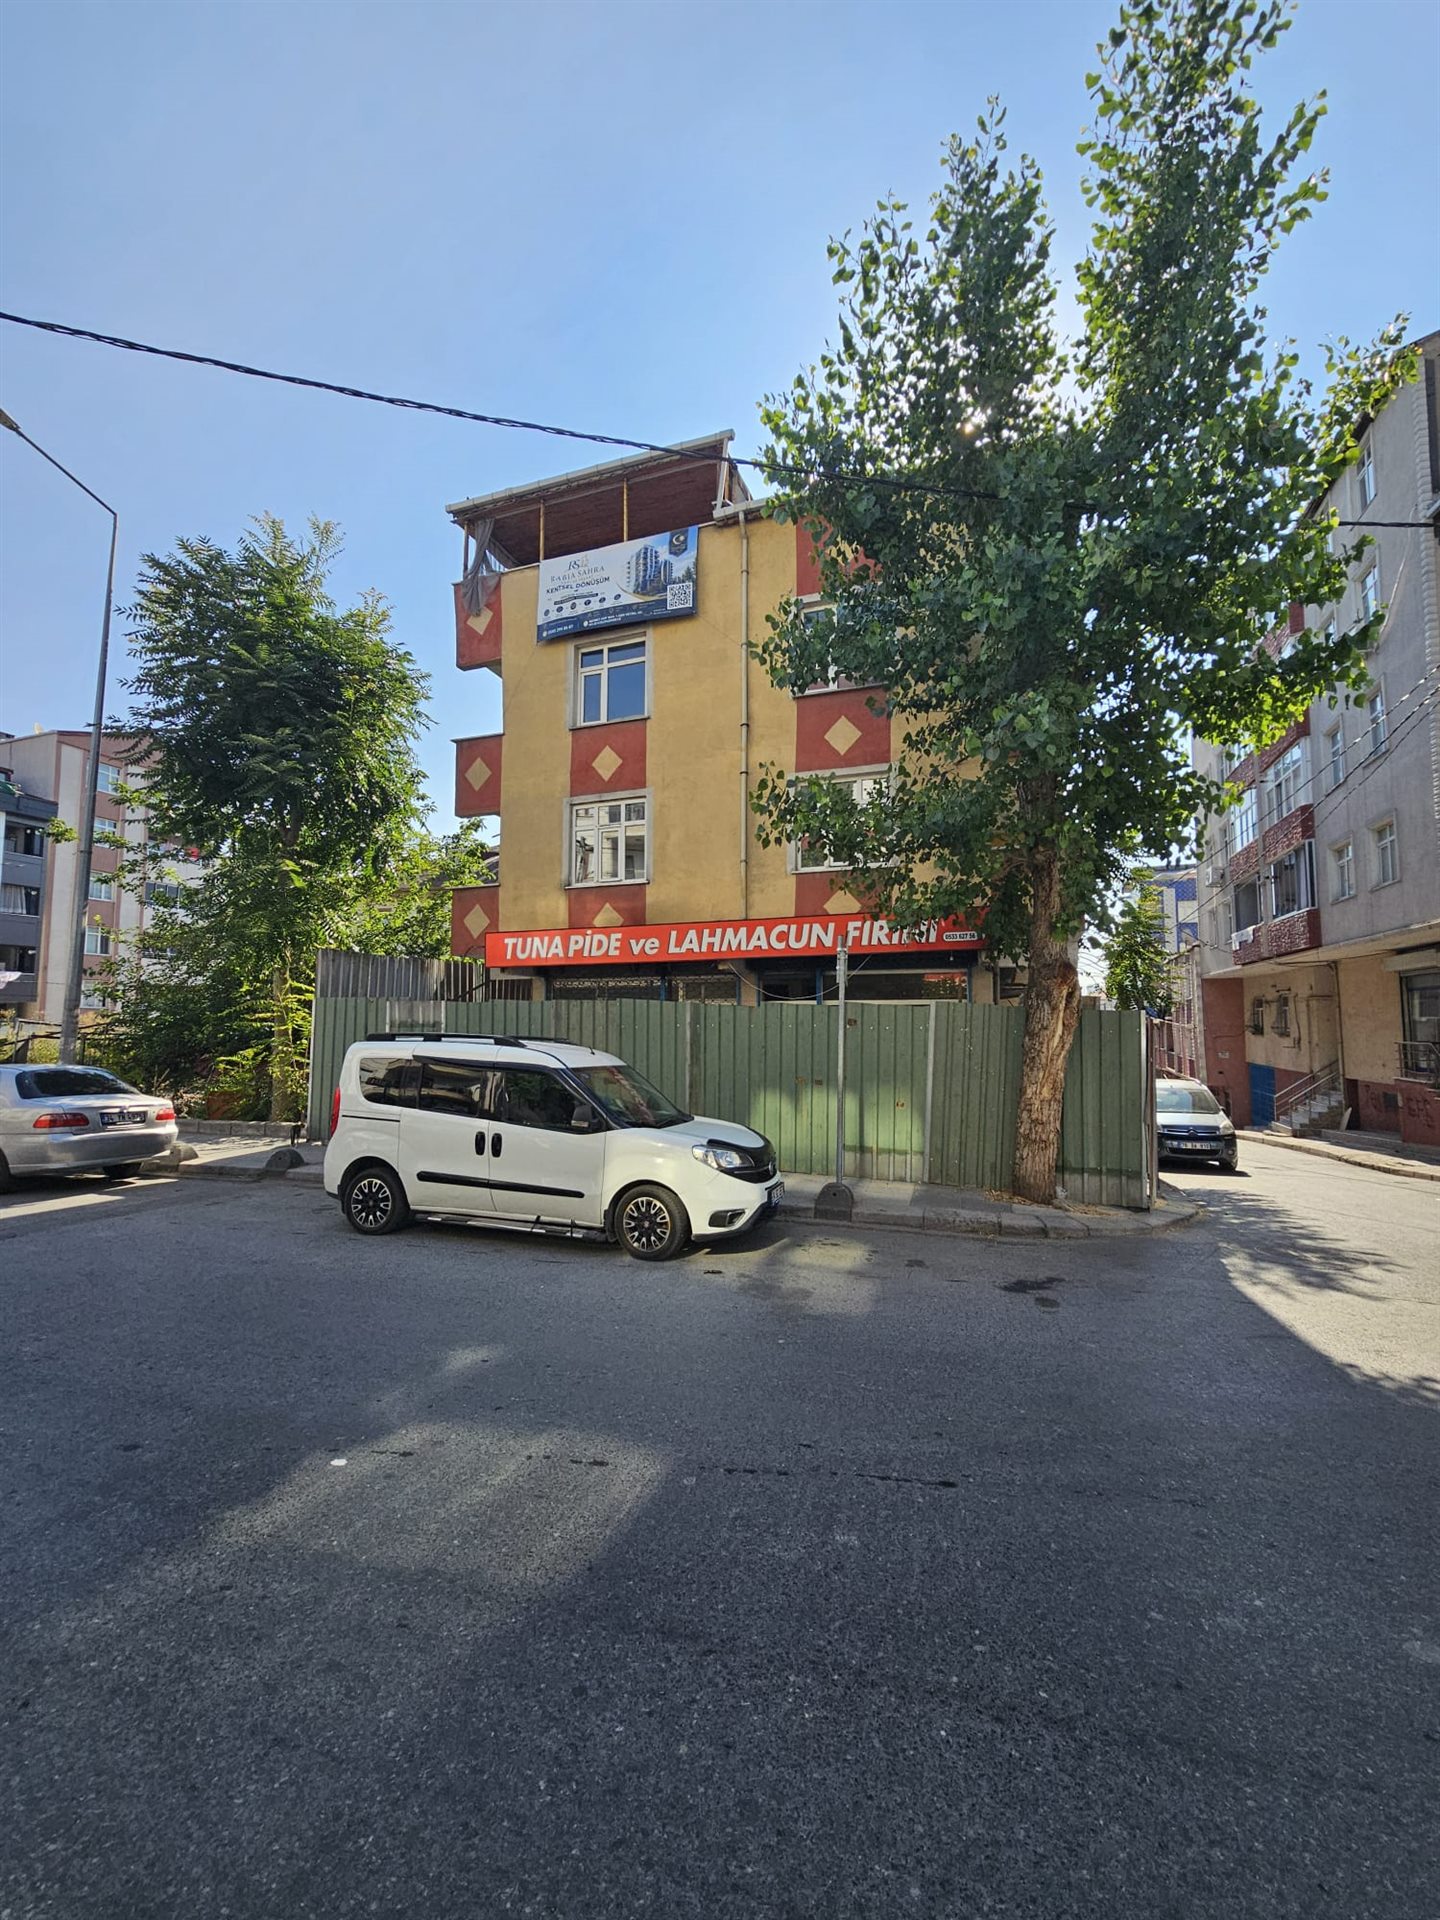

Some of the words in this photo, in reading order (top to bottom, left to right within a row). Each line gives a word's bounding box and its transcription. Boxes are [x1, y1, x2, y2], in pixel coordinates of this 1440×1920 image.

[546, 583, 574, 595] KENTSEL
[504, 935, 565, 960] TUNA
[567, 929, 623, 957] PİDE
[629, 936, 661, 956] ve
[667, 922, 836, 954] LAHMACUN
